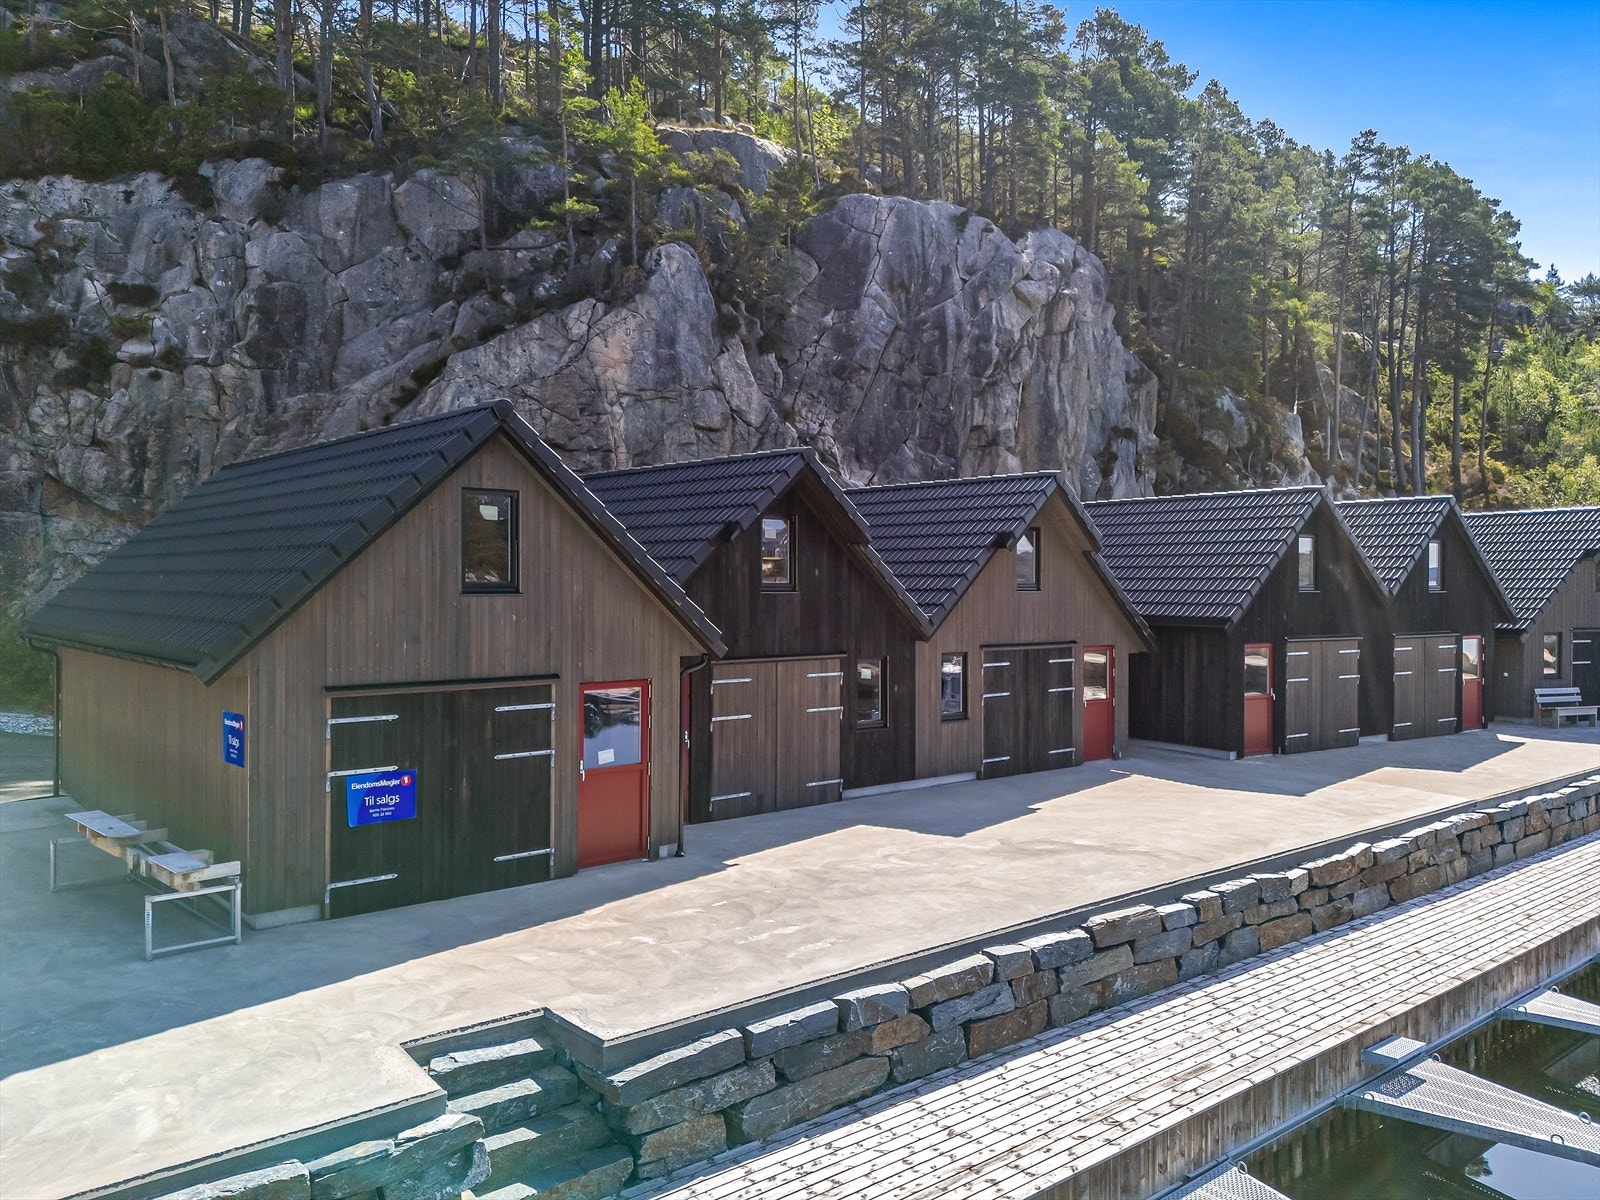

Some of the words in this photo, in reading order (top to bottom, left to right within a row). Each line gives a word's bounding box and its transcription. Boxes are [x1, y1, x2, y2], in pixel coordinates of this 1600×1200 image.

[352, 779, 400, 790] EiendomsMegler
[364, 796, 374, 806] Til
[376, 794, 400, 806] salgs
